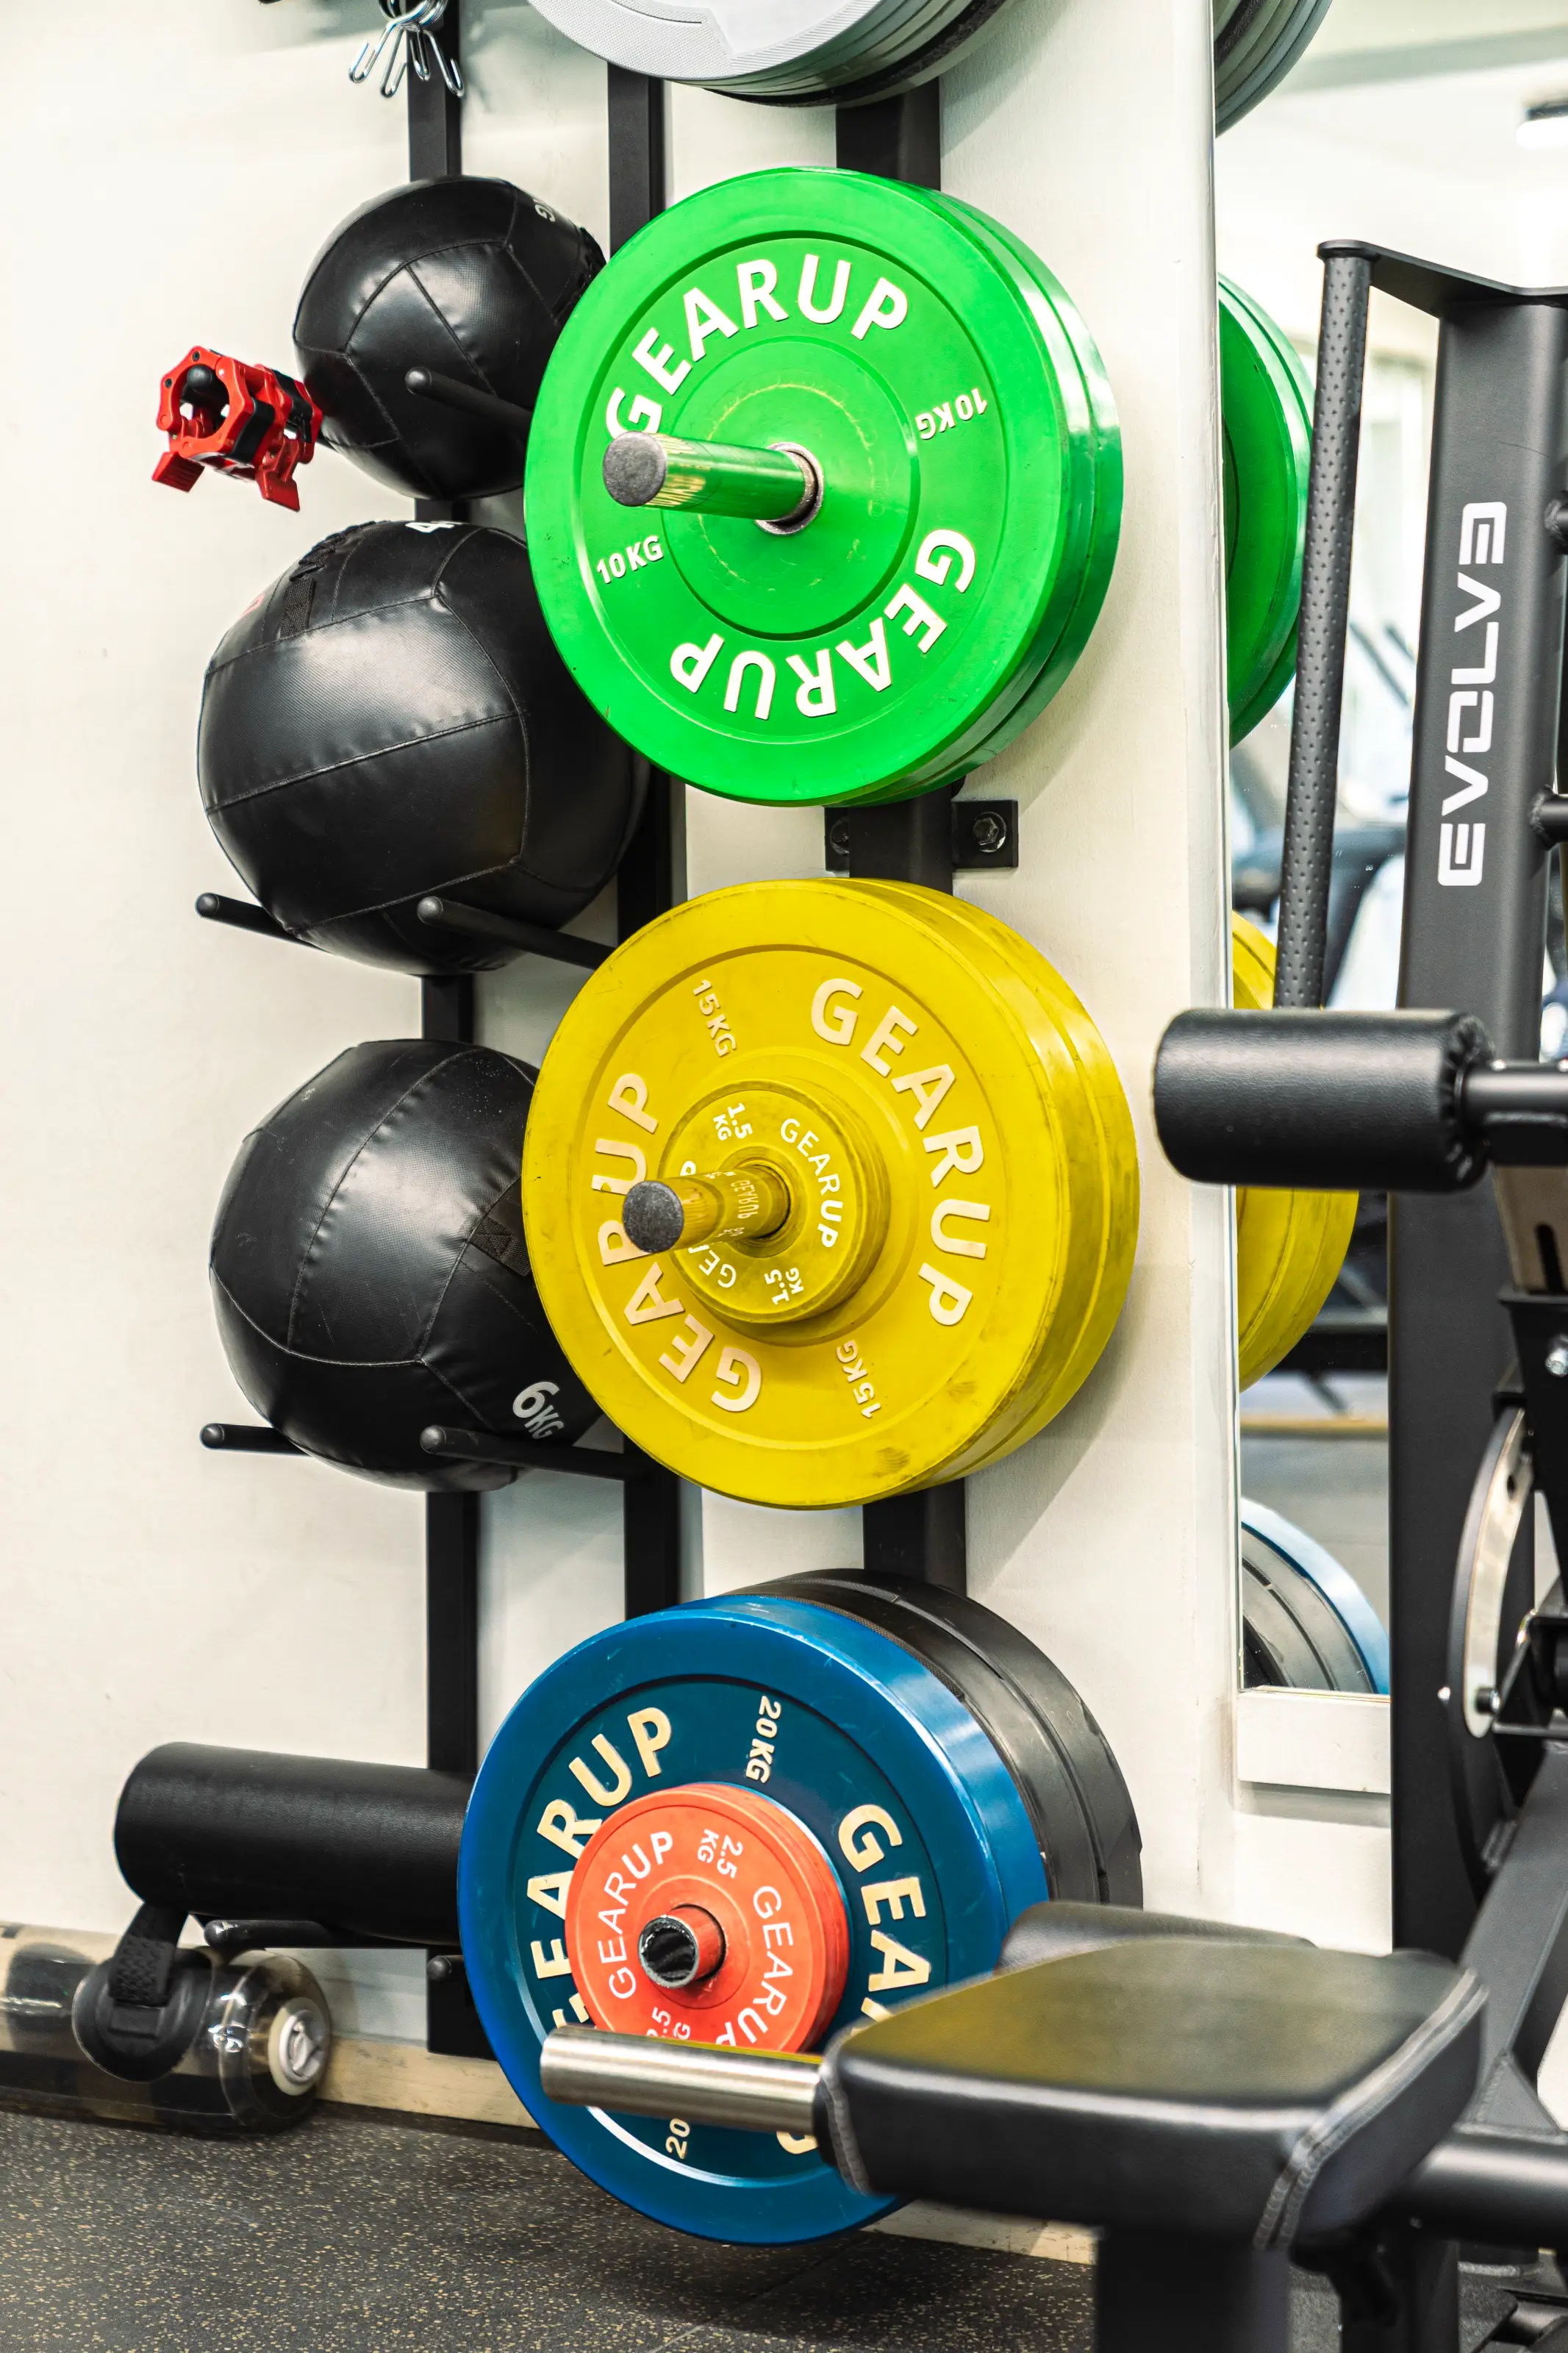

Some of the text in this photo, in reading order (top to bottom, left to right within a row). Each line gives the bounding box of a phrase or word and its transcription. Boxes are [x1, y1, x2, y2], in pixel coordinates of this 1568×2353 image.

[605, 253, 908, 440] GEARUP
[670, 529, 975, 720] GEARUP
[1438, 501, 1507, 885] EVOLVE
[713, 1114, 732, 1140] KG
[727, 1103, 753, 1138] 1.5
[810, 978, 990, 1327] GEARUP
[780, 1118, 843, 1248] GEARUP
[764, 1269, 790, 1305] 1.5
[785, 1268, 804, 1294] KG
[526, 1707, 672, 2028] EARUP
[698, 1829, 720, 1864] KG
[716, 1835, 743, 1879] 2.5
[598, 1831, 673, 1999] GEARUP
[673, 2021, 691, 2040] G
